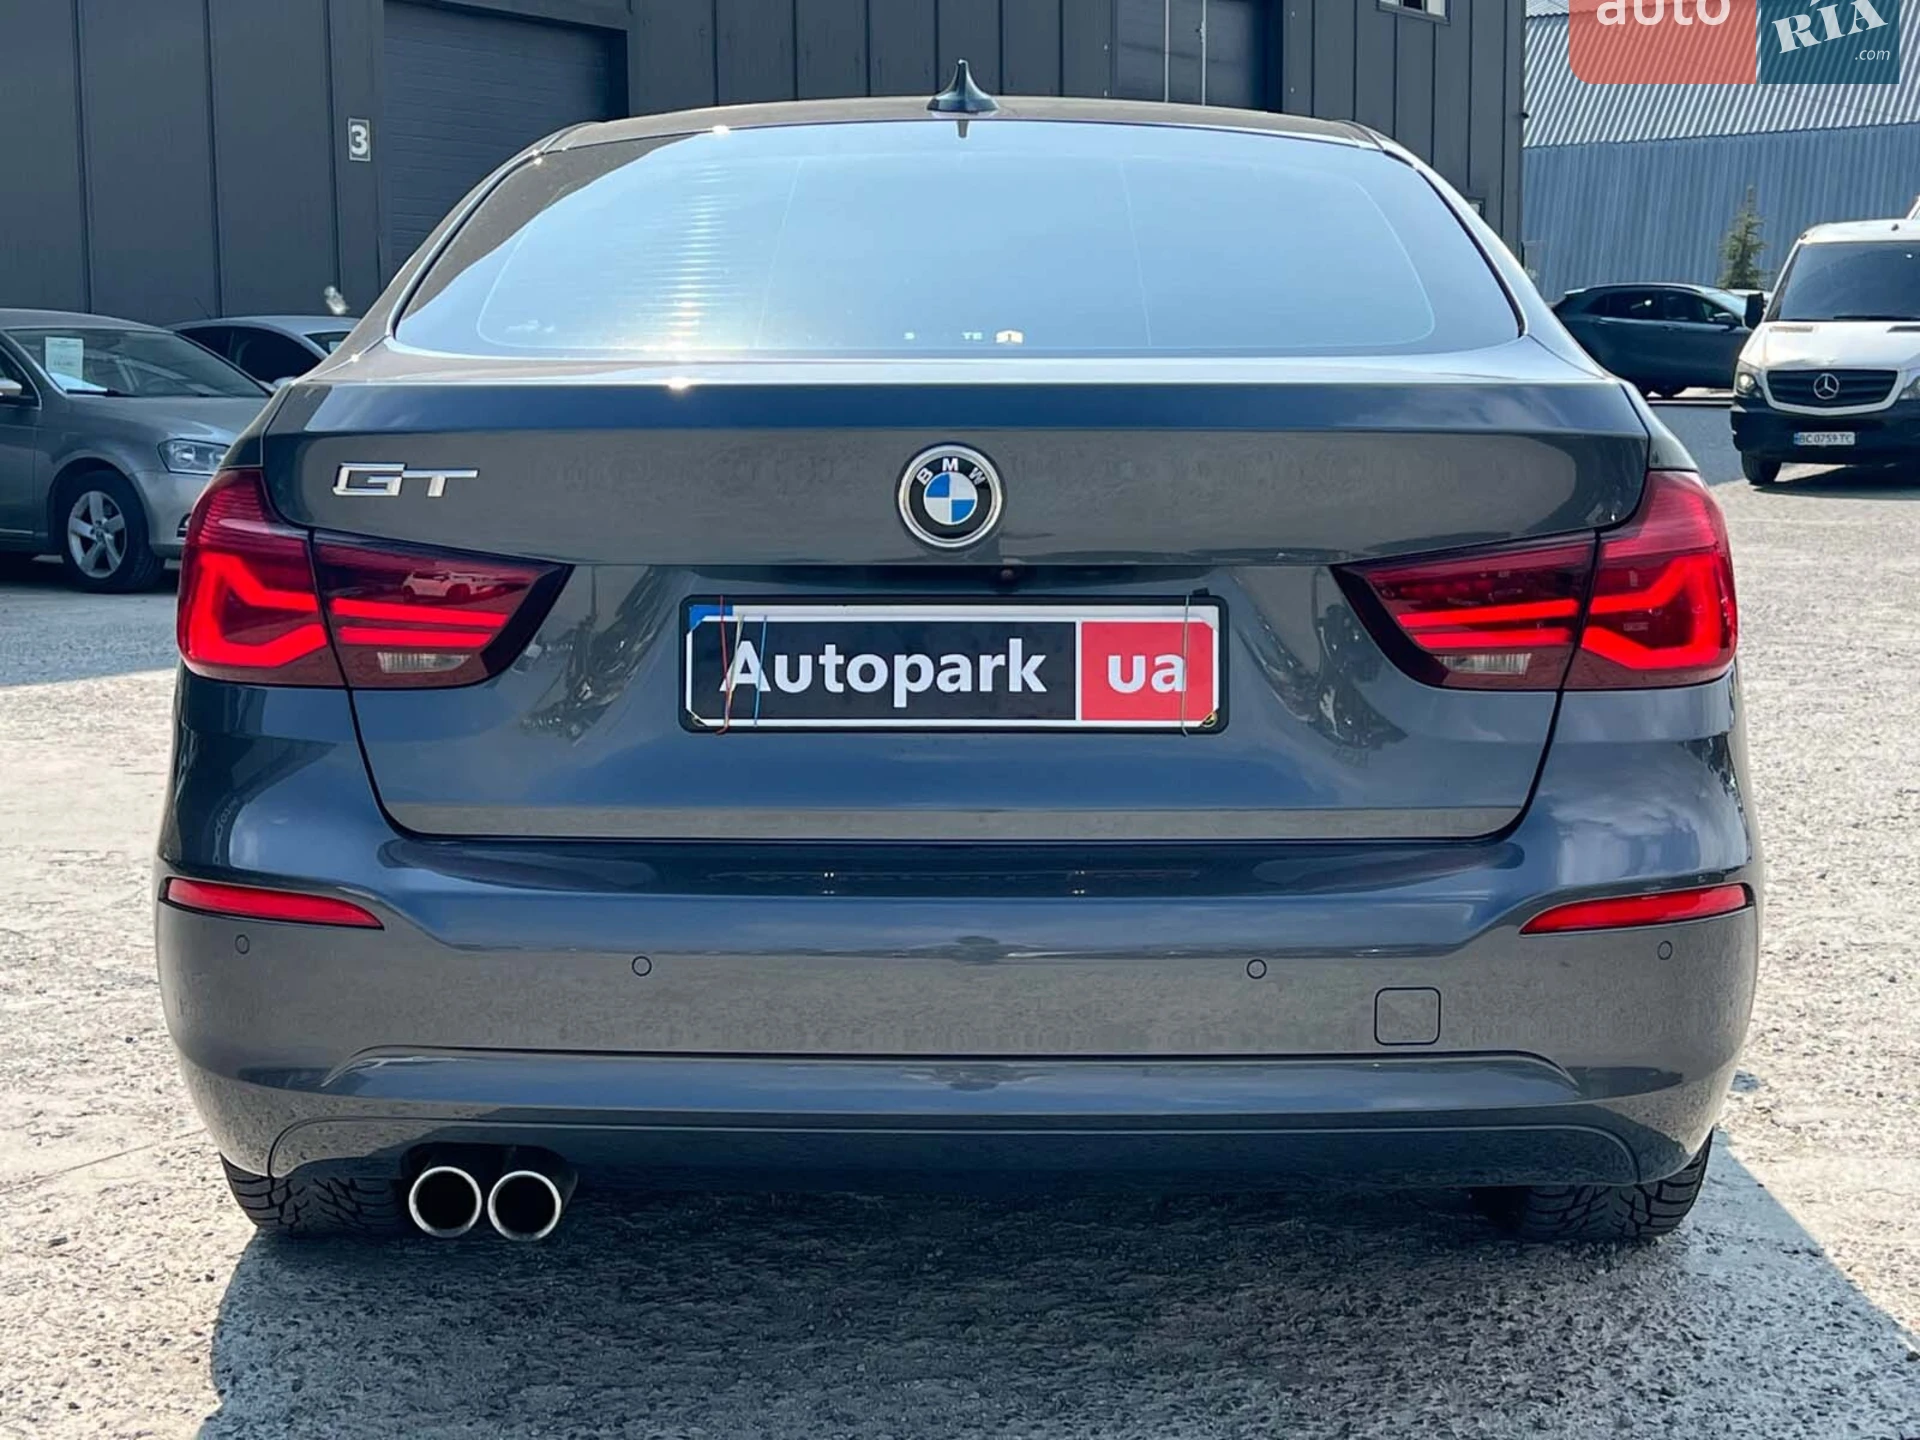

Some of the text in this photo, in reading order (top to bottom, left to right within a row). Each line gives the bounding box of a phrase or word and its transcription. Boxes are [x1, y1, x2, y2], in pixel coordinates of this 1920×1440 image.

[351, 124, 367, 156] 3
[333, 462, 479, 497] GT
[916, 457, 986, 486] BMW
[719, 638, 1188, 708] Autopark ua
